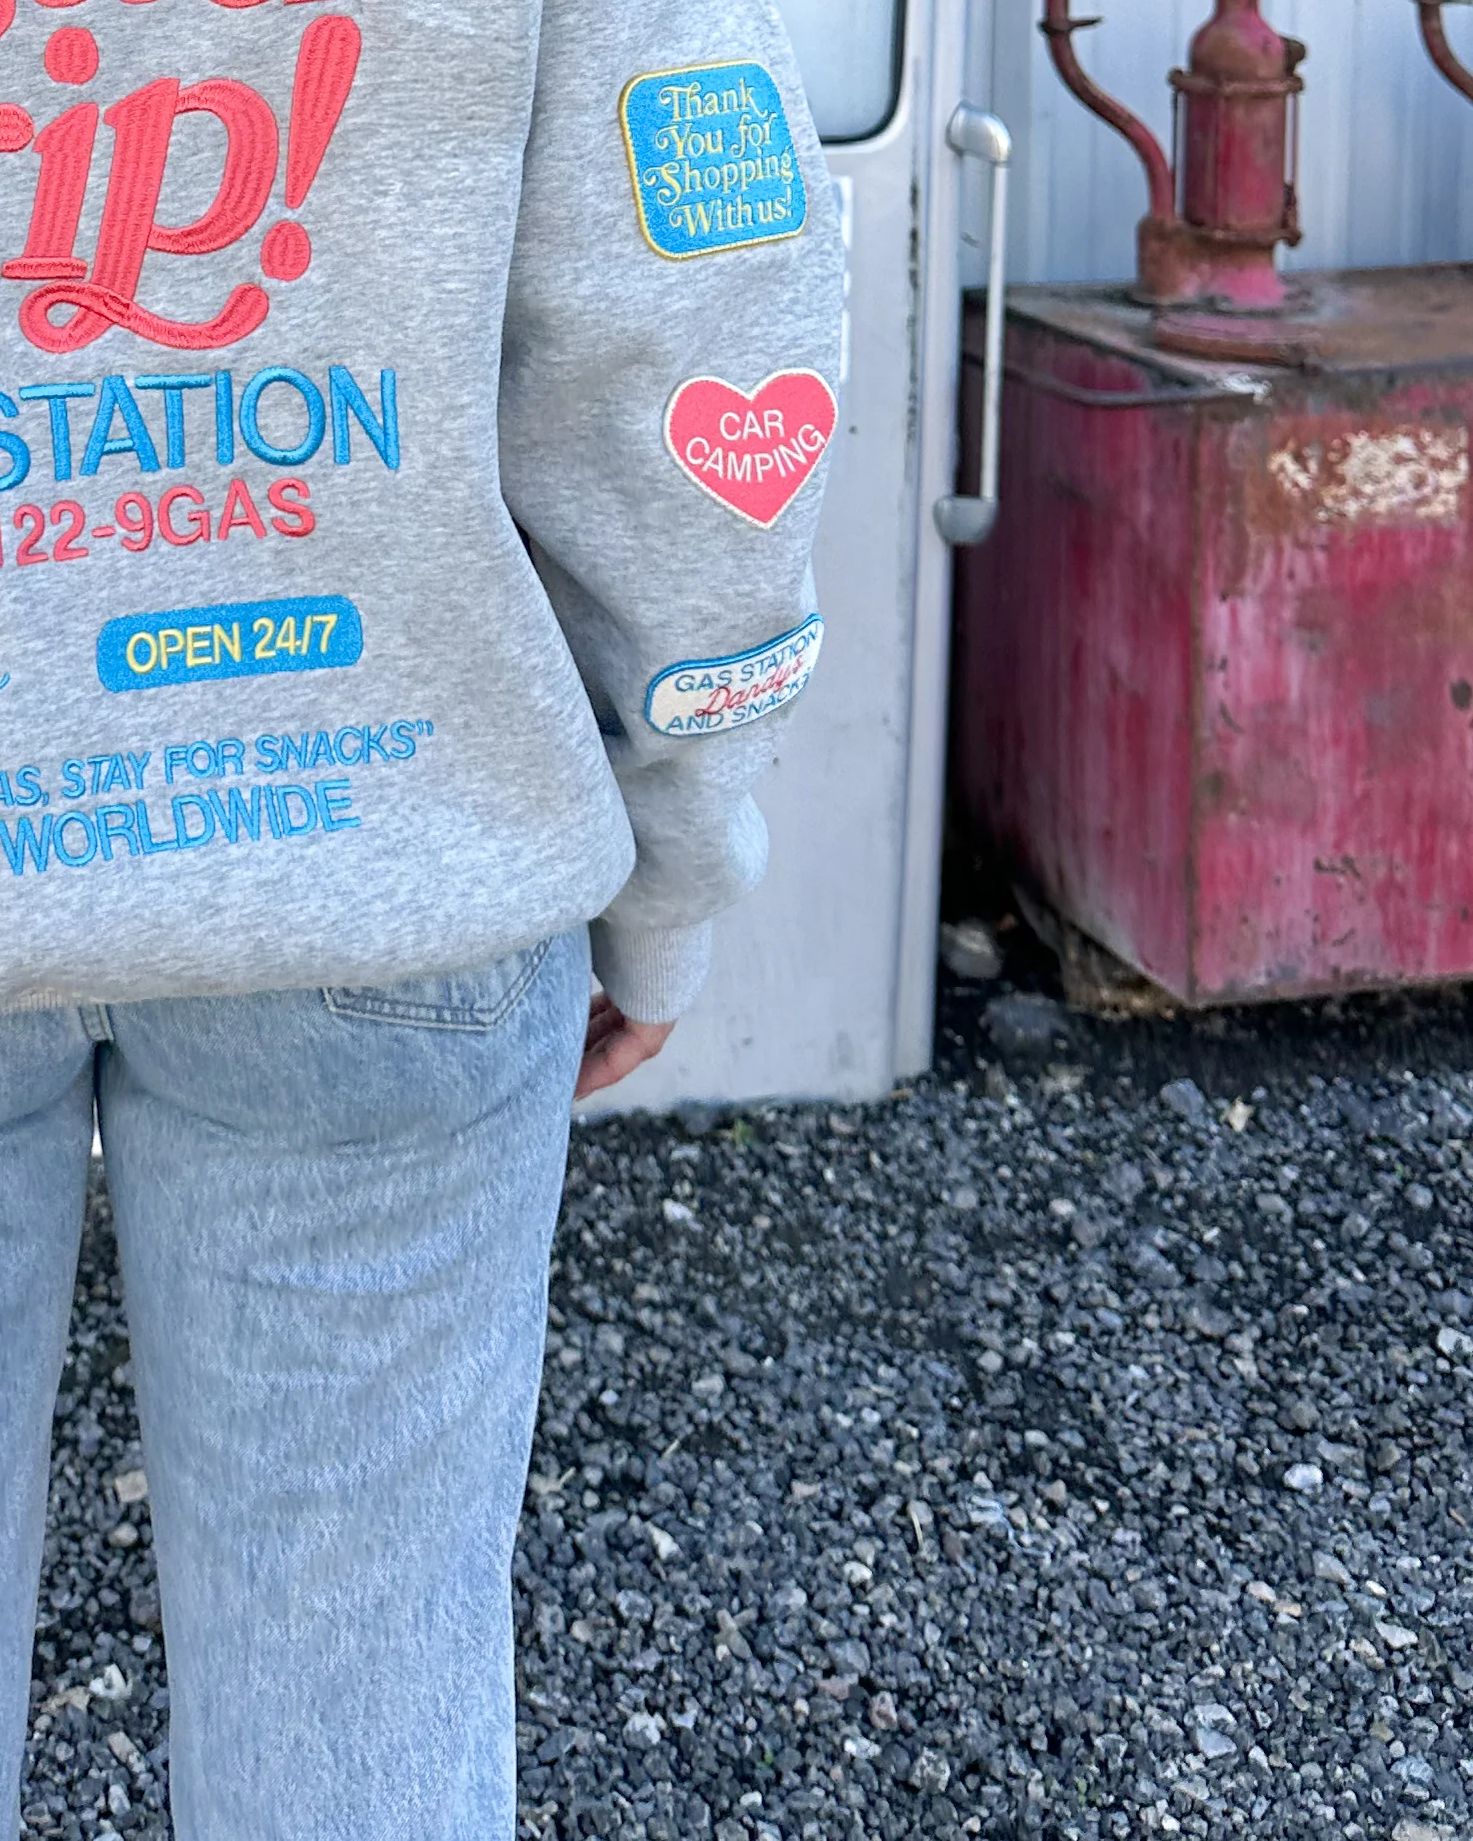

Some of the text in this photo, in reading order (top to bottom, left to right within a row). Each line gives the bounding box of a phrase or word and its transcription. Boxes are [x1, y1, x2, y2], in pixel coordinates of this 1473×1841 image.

[659, 77, 768, 122] Thank
[655, 112, 777, 159] You for
[643, 147, 794, 206] Shopping
[669, 185, 792, 237] With us!
[719, 409, 785, 441] CAR
[685, 423, 826, 484] CAMPING
[126, 614, 339, 674] OPEN 24/7
[674, 623, 818, 692] GAS STATION
[665, 711, 724, 731] AND
[62, 750, 152, 799] STAY
[164, 738, 245, 784] FOR
